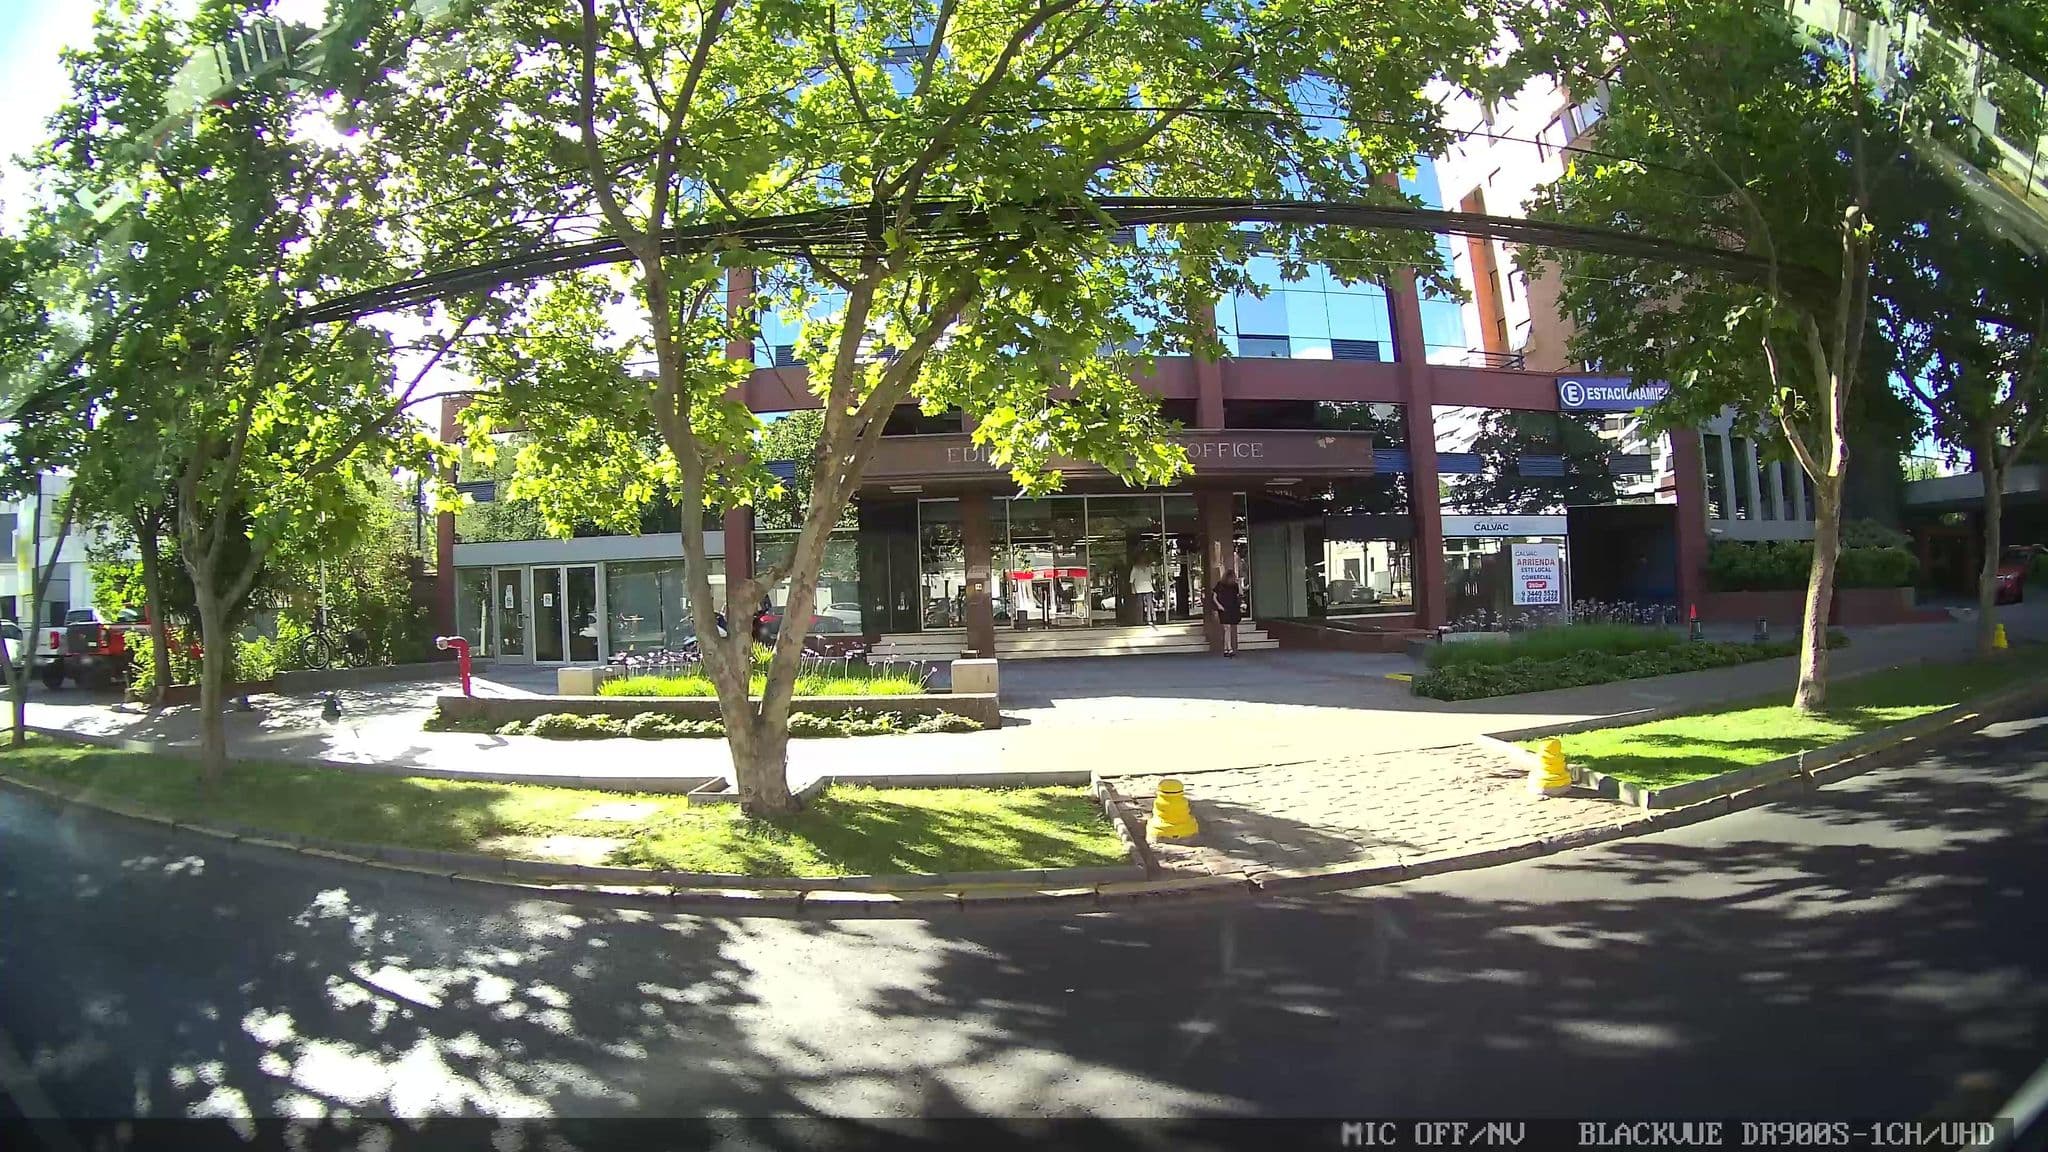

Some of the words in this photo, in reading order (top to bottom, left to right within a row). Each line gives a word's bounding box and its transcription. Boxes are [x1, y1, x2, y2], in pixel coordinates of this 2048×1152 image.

[1187, 443, 1264, 459] OFFICE
[1474, 523, 1509, 531] CALVAC
[1517, 558, 1556, 566] ARRIENDA
